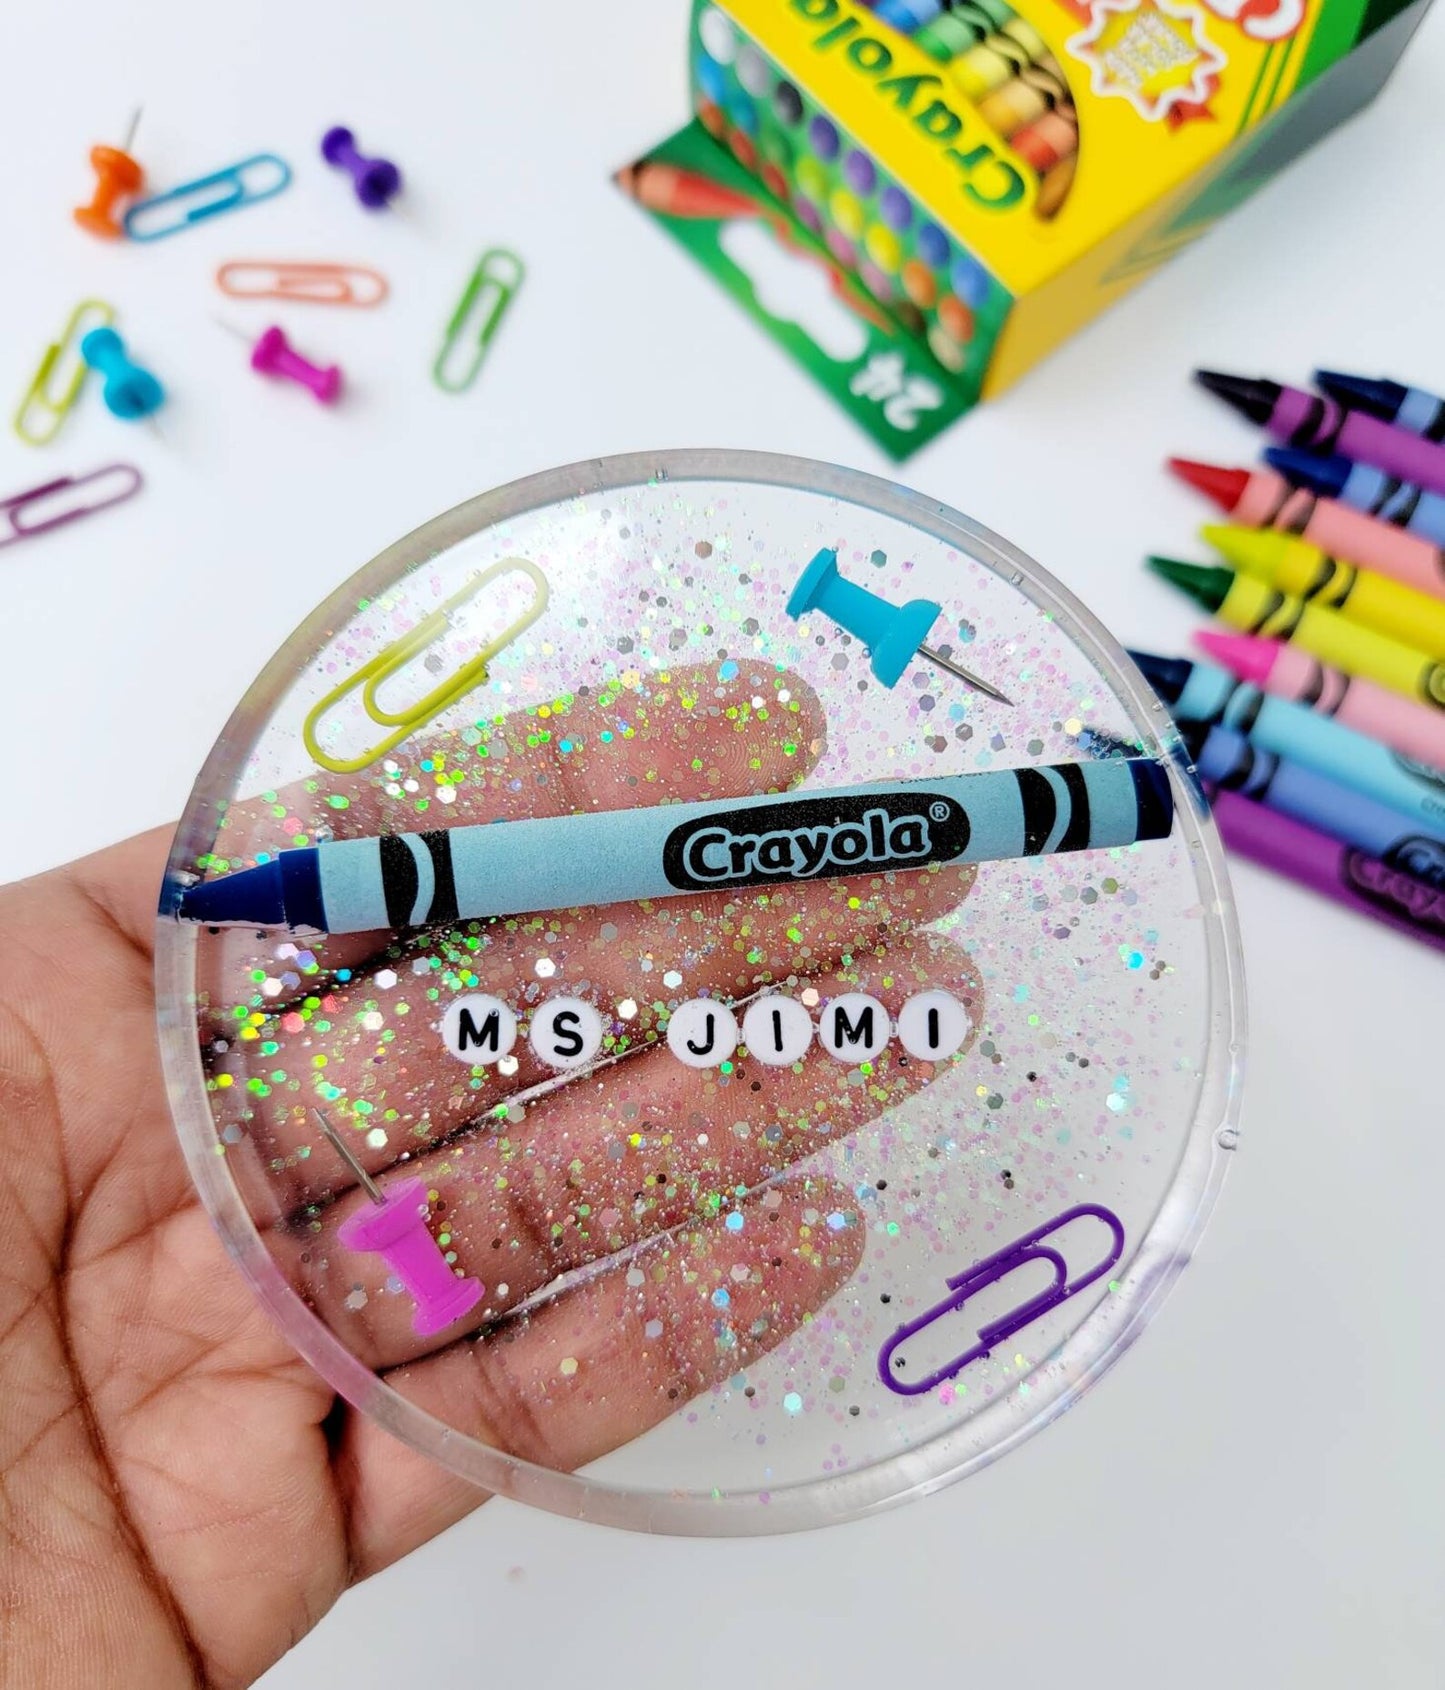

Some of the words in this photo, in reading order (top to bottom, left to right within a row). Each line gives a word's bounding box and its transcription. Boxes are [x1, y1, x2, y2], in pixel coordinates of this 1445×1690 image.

[849, 351, 943, 431] 24
[456, 1006, 585, 1058] MS
[685, 1005, 940, 1057] JIMI
